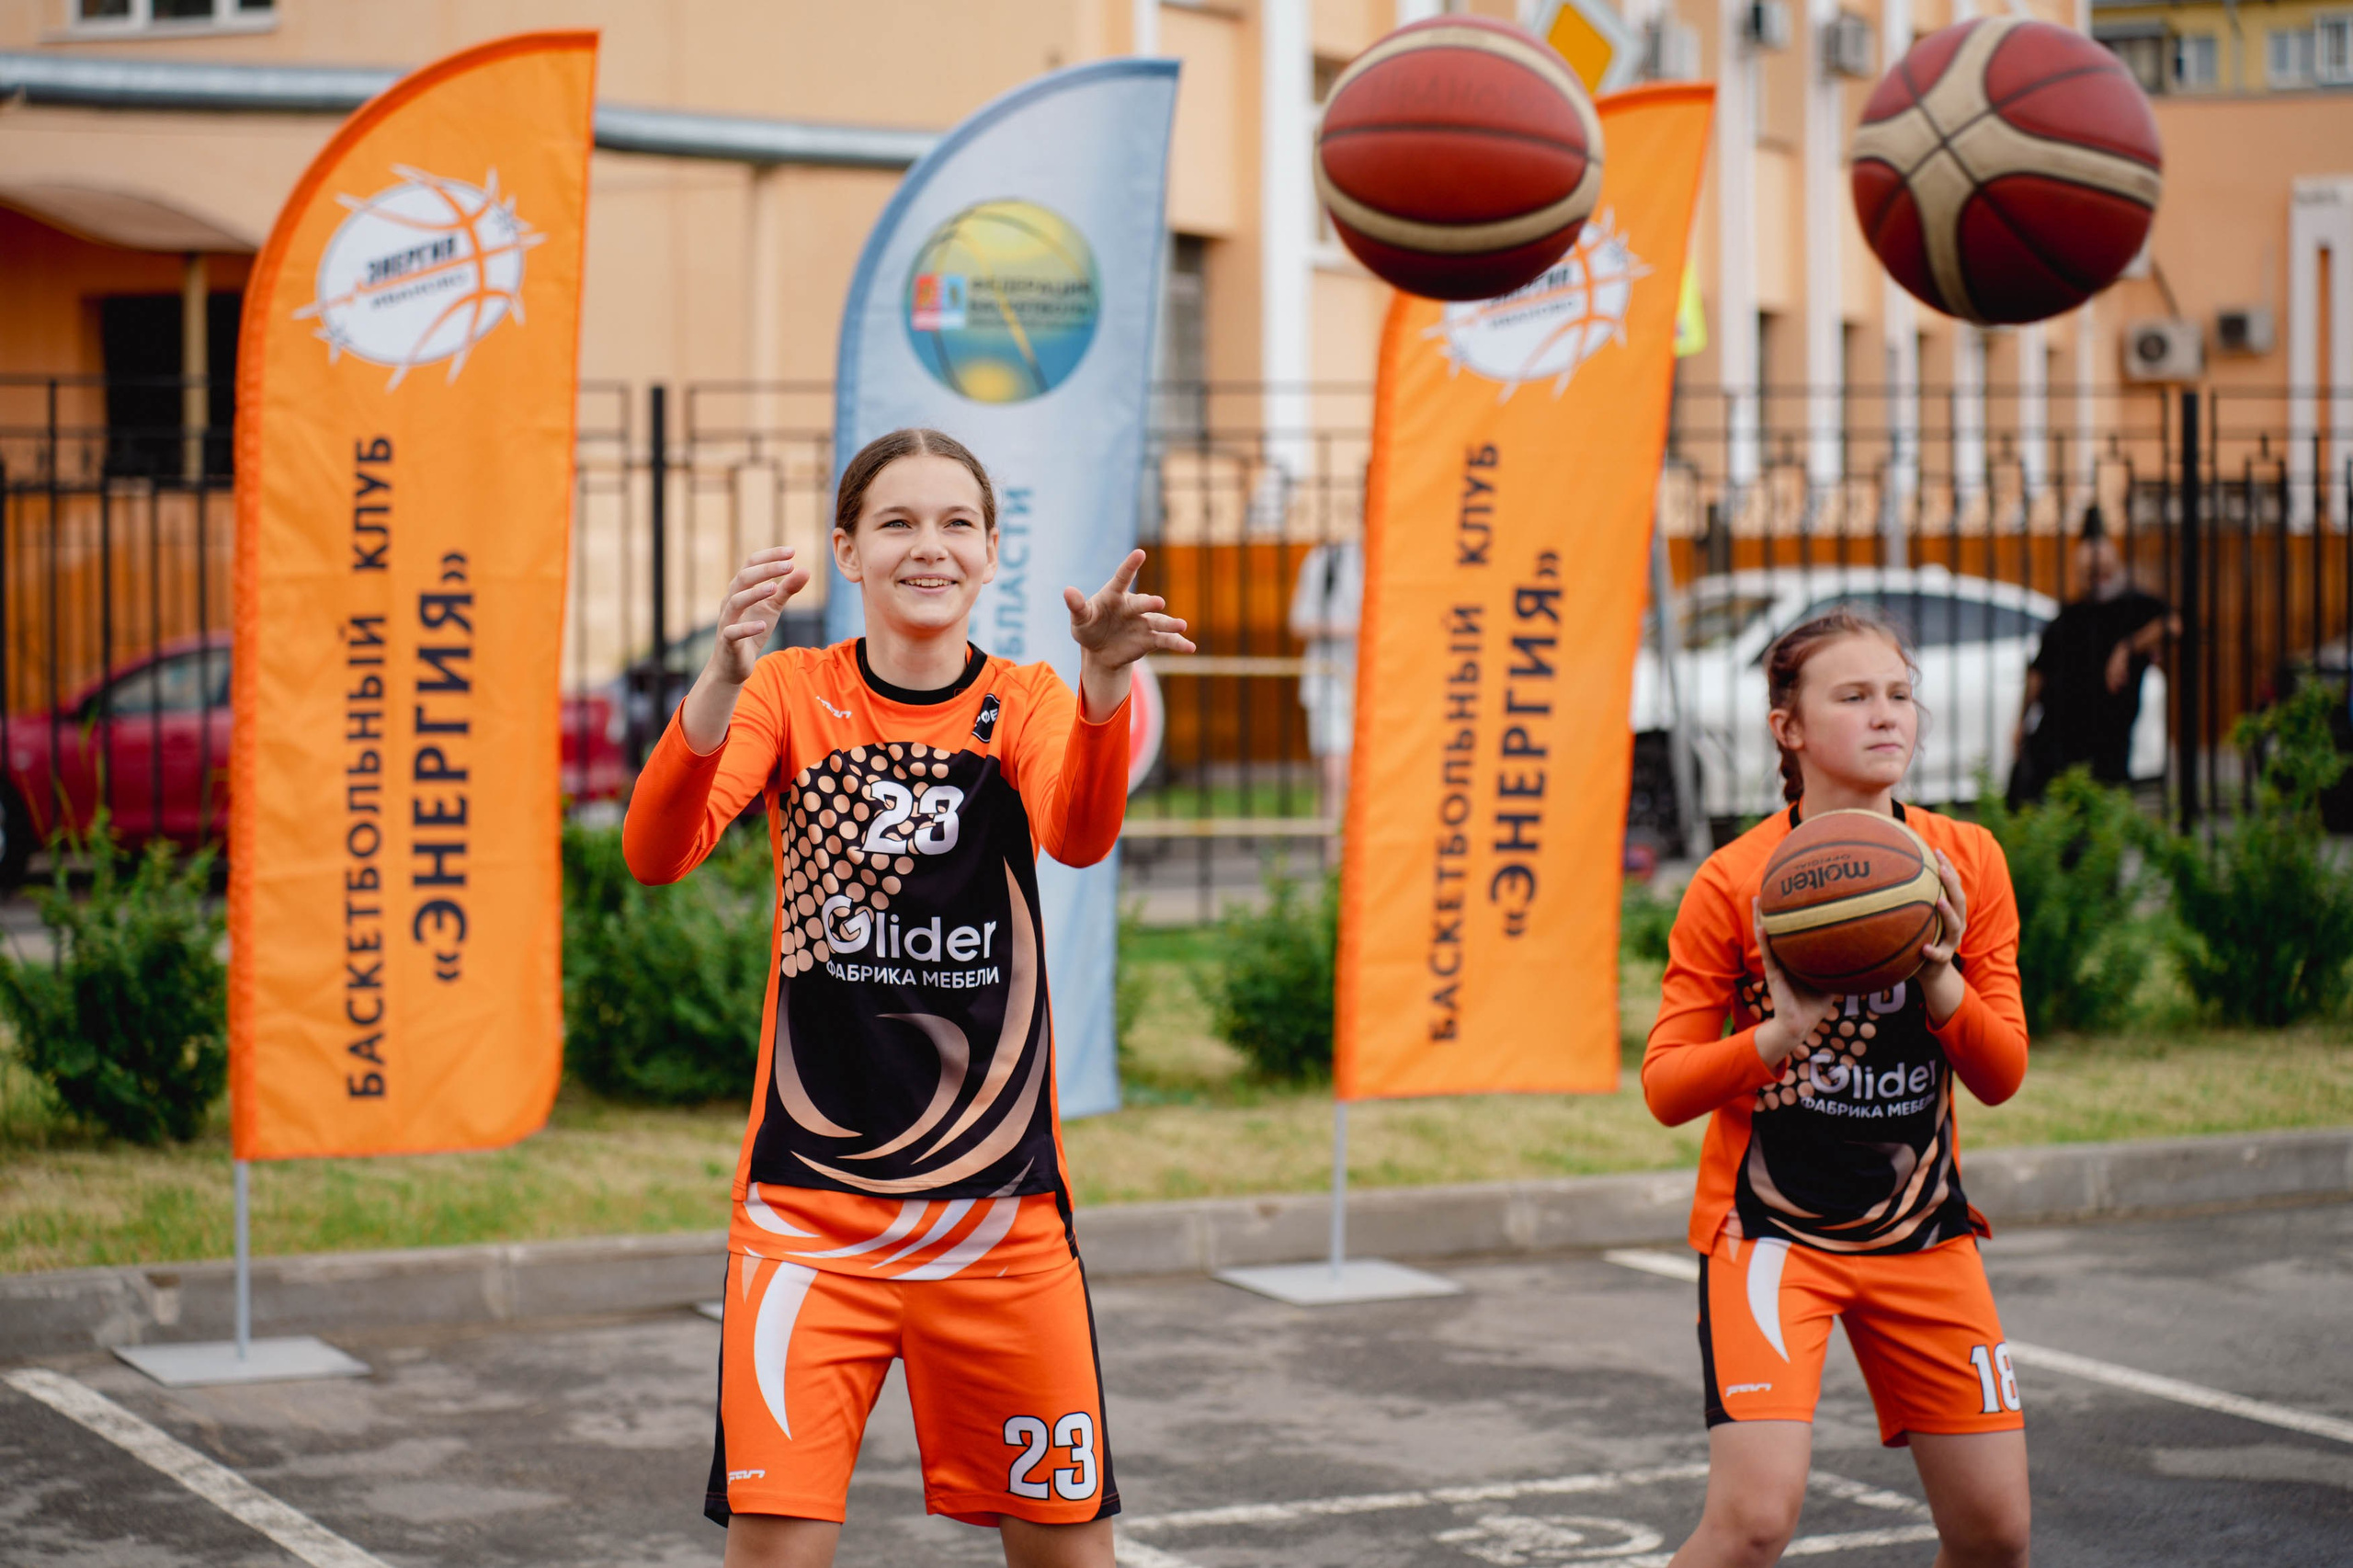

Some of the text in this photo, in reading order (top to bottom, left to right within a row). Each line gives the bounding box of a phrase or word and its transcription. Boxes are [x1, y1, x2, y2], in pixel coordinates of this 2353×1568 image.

[993, 485, 1035, 657] БЛАСТИ
[337, 437, 392, 1098] БАСКЕТБОЛЬНЫЙ КЛУБ
[412, 551, 474, 982] «ЭНЕРГИЯ»
[1428, 443, 1499, 1044] БАСКЕТБОЛЬНЫЙ КЛУБ
[1487, 549, 1563, 940] «ЭНЕРГИЯ»
[860, 779, 966, 857] 23
[1780, 860, 1871, 897] molten
[821, 894, 997, 962] Glider
[825, 960, 1000, 989] ФАБРИКА МЕБЕЛИ
[1800, 1096, 1883, 1119] ФАБРИКА
[1969, 1341, 2022, 1414] 18
[1003, 1411, 1098, 1502] 23
